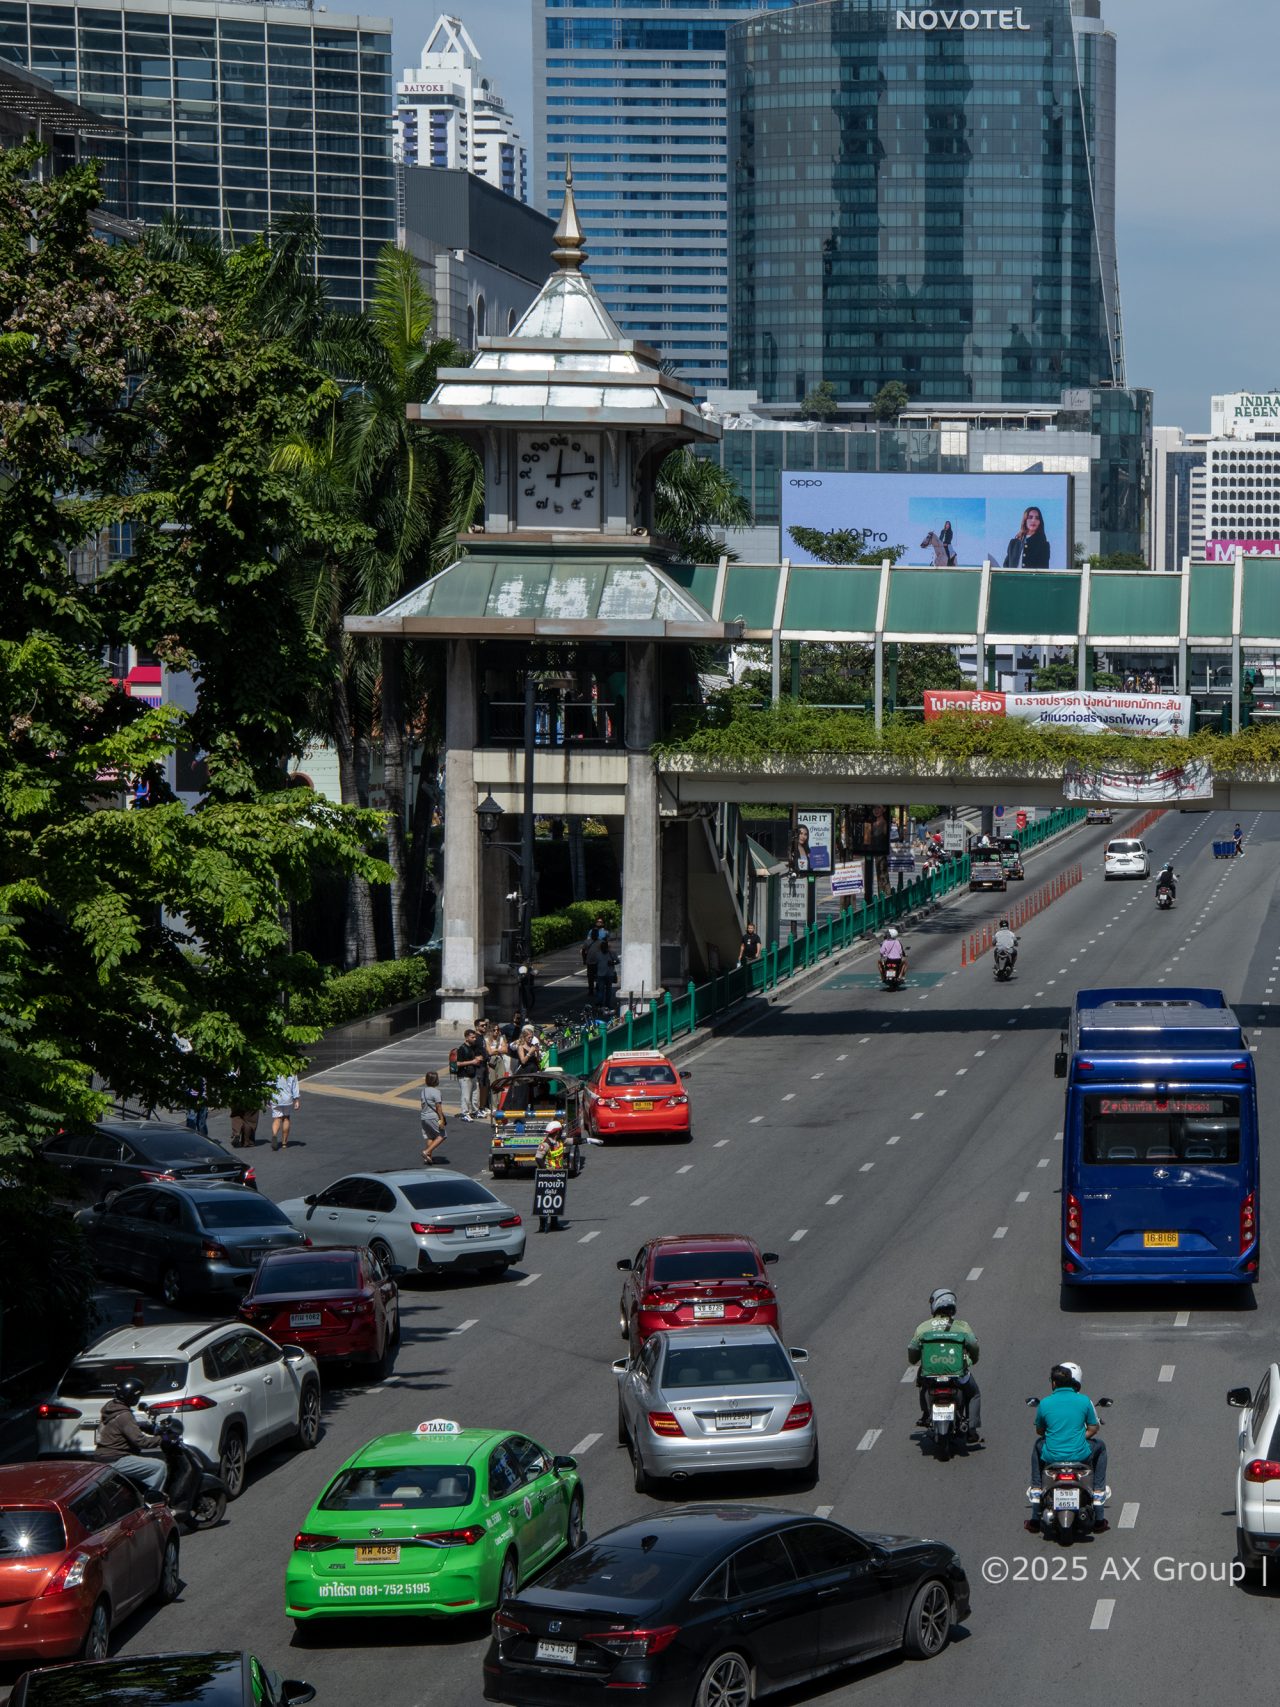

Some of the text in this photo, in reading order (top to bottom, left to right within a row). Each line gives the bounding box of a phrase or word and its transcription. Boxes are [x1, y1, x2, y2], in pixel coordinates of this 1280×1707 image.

[895, 7, 1031, 30] NOVOTEL
[403, 84, 445, 92] BAIYOKE
[789, 478, 823, 488] oppo
[537, 1179, 565, 1188] ทางเข้า
[537, 1195, 563, 1209] 100
[1146, 1233, 1177, 1242] 16-8166
[930, 1354, 956, 1365] Grab
[429, 1423, 446, 1432] TAXI
[376, 1545, 397, 1555] 4699
[359, 1583, 404, 1596] 081-752
[405, 1582, 431, 1594] 5195
